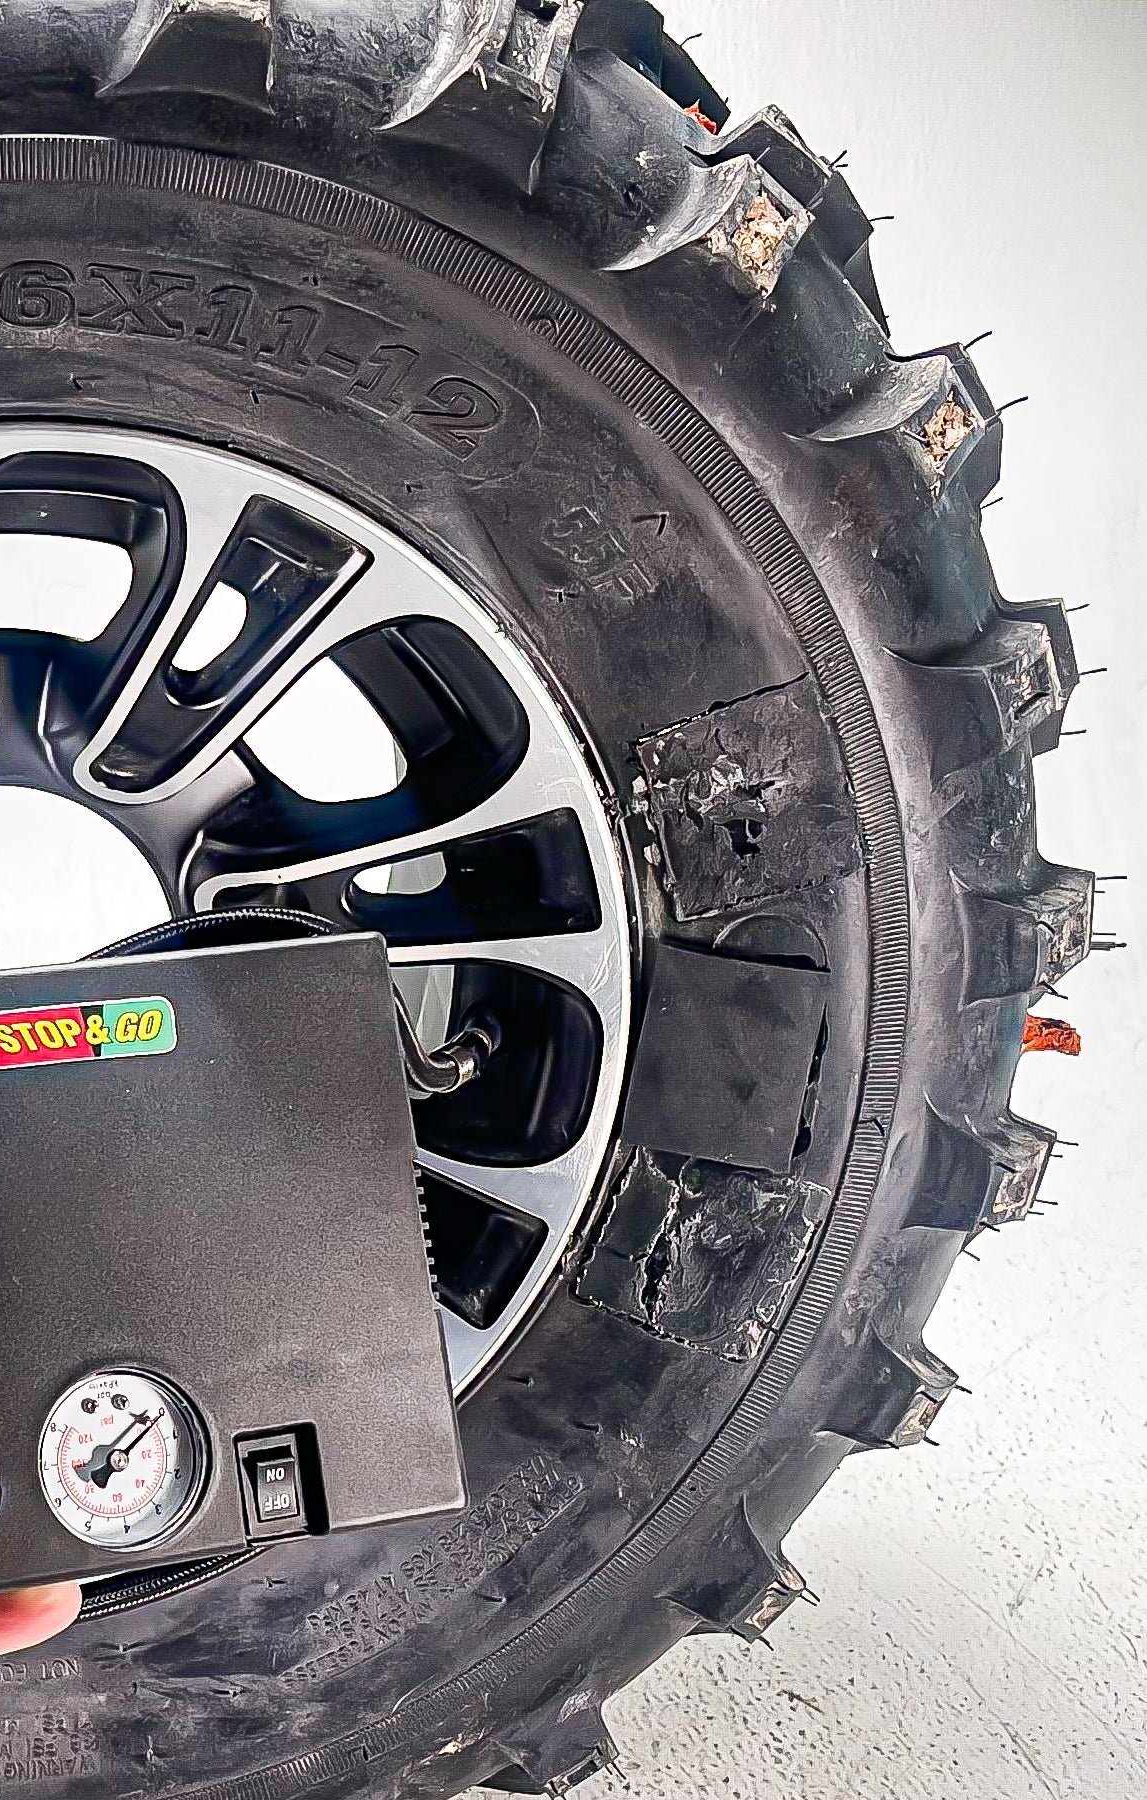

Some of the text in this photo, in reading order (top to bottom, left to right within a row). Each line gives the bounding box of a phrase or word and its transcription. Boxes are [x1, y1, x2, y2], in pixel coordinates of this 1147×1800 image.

[85, 1014, 112, 1046] &
[115, 1009, 163, 1043] GO
[50, 1423, 56, 1432] 8
[78, 1433, 94, 1444] 120
[141, 1450, 152, 1459] 20
[44, 1460, 49, 1471] 7
[174, 1468, 182, 1479] 2
[266, 1467, 285, 1483] ON
[55, 1497, 62, 1507] 6
[264, 1493, 290, 1512] OFF
[155, 1505, 162, 1515] 3
[85, 1520, 92, 1532] 5
[124, 1524, 131, 1534] 4
[41, 1657, 81, 1680] NOT
